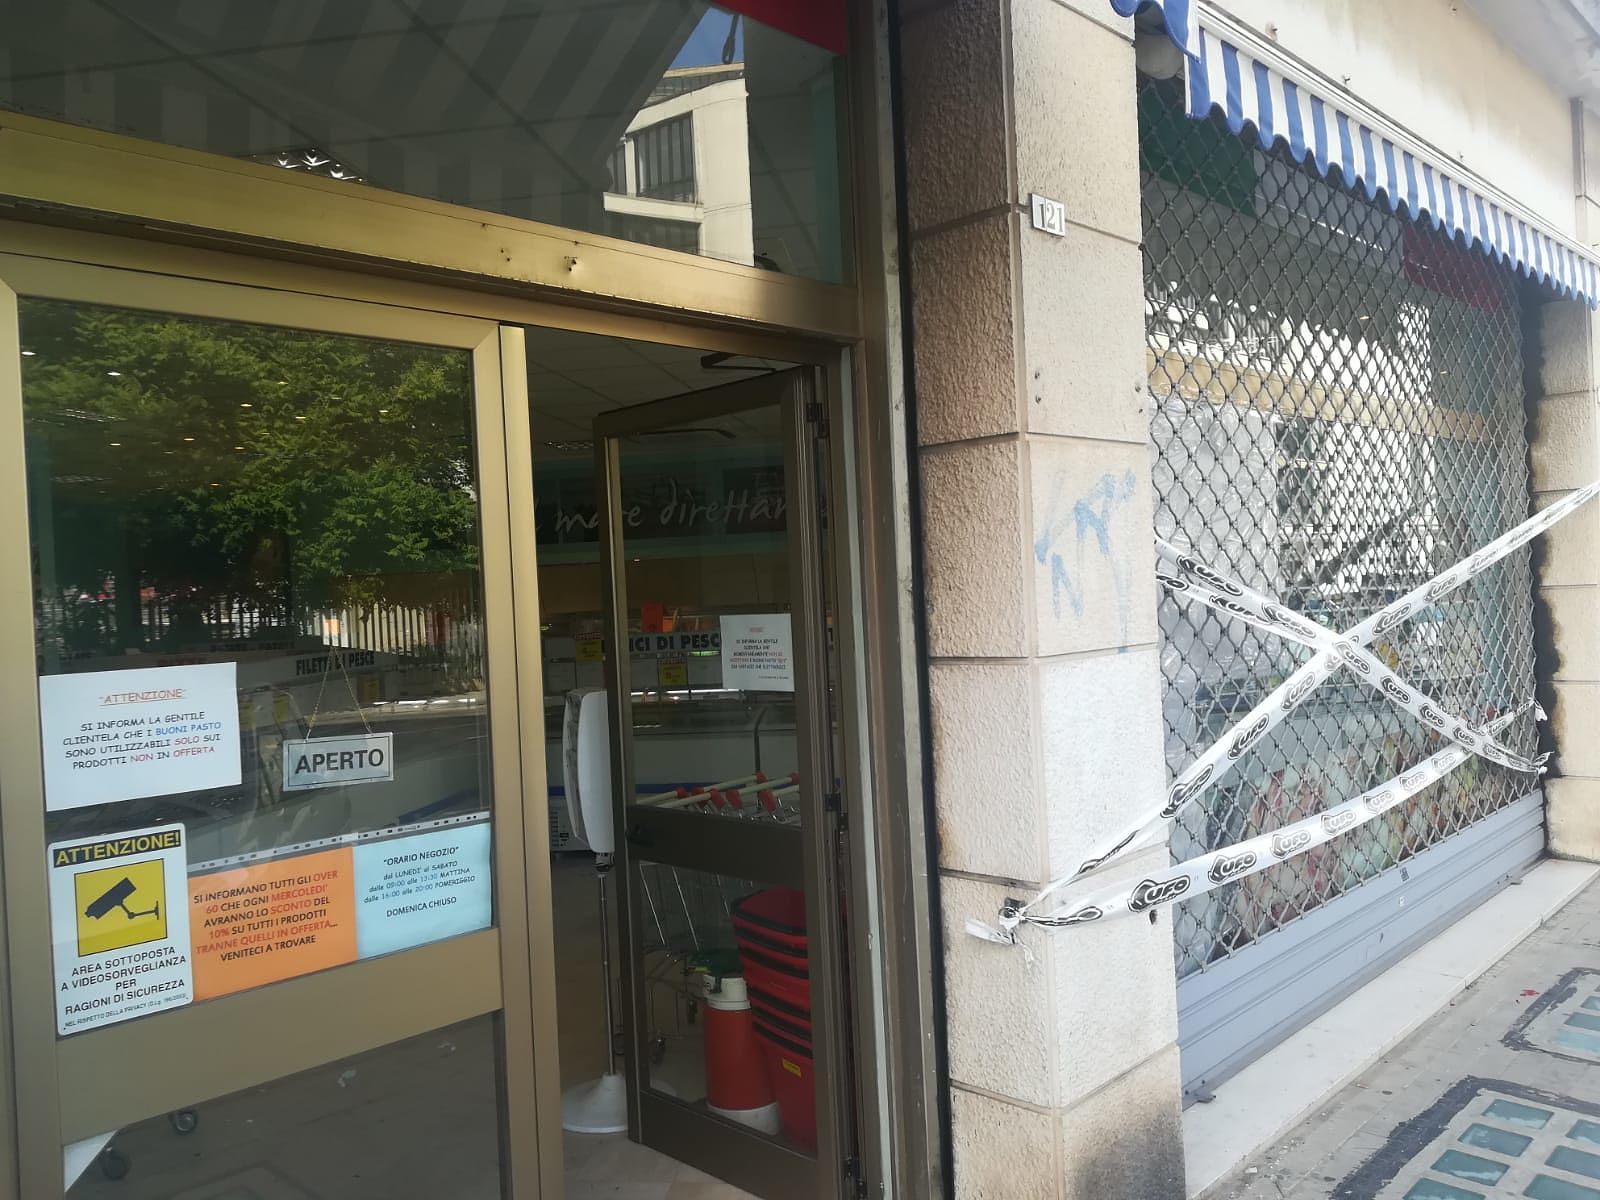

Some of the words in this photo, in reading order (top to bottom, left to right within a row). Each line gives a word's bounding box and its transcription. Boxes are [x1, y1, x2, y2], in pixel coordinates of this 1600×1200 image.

[1039, 202, 1064, 233] 121
[656, 635, 675, 650] DI
[681, 632, 721, 649] PESC
[1344, 649, 1371, 674] UFO
[63, 731, 120, 746] CLIENTELA
[123, 729, 143, 740] CHE
[155, 725, 188, 736] BUONI
[191, 721, 222, 733] PASTO
[80, 722, 93, 732] SI
[97, 717, 145, 730] INFORMA
[149, 716, 161, 725] LA
[164, 711, 206, 723] GENTILE
[65, 747, 97, 759] SONO
[100, 739, 171, 755] UTILIZZABILI
[174, 735, 200, 746] SOLO
[203, 733, 221, 743] SUI
[73, 756, 127, 770] PRODOTTI
[130, 753, 154, 763] NON
[157, 751, 170, 760] IN
[173, 746, 216, 758] OFFERTA
[294, 748, 385, 775] APERTO
[55, 831, 181, 866] ATTENZIONE!
[1146, 878, 1189, 902] UFO
[1221, 852, 1256, 876] UFO
[1280, 830, 1311, 850] UFO
[1330, 811, 1355, 829] UFO
[1371, 791, 1394, 809] UFO
[368, 884, 385, 893] dalle
[407, 878, 418, 886] alle
[440, 867, 471, 879] MATTINA
[383, 872, 394, 881] dal
[431, 860, 458, 872] SABATO
[193, 895, 203, 905] SI
[205, 883, 267, 903] INFORMANO
[269, 878, 296, 891] TUTTI
[296, 875, 312, 886] GLI
[313, 870, 339, 882] OVER
[205, 904, 219, 915] 60
[220, 900, 241, 912] CHE
[243, 895, 269, 907] OGNI
[271, 884, 329, 903] MERCOLEDI'
[363, 895, 380, 904] dalle
[402, 888, 413, 896] alle
[434, 875, 477, 889] POMERIGGIO
[203, 910, 255, 929] AVRANNO
[256, 908, 269, 918] LO
[270, 899, 312, 916] SCONTO
[313, 896, 331, 907] DEL
[386, 902, 429, 918] DOMENICA
[429, 896, 458, 909] CHIUSO
[209, 927, 231, 940] 10%
[231, 925, 245, 935] SU
[247, 919, 274, 932] TUTTI
[280, 908, 327, 925] PRODOTTI
[195, 938, 240, 955] TRANNE
[240, 931, 275, 947] QUELLI
[277, 928, 289, 939] IN
[220, 946, 264, 962] VENITECI
[265, 943, 274, 953] A
[275, 934, 317, 951] TROVARE
[60, 982, 69, 992] A
[71, 955, 187, 990] VIDEOSORVEGLIANZA
[71, 962, 103, 977] AREA
[105, 946, 176, 970] SOTTOPOSTA
[65, 995, 111, 1016] RAGIONI
[113, 993, 125, 1004] DI
[126, 979, 185, 1001] SICUREZZA
[115, 978, 137, 991] PER
